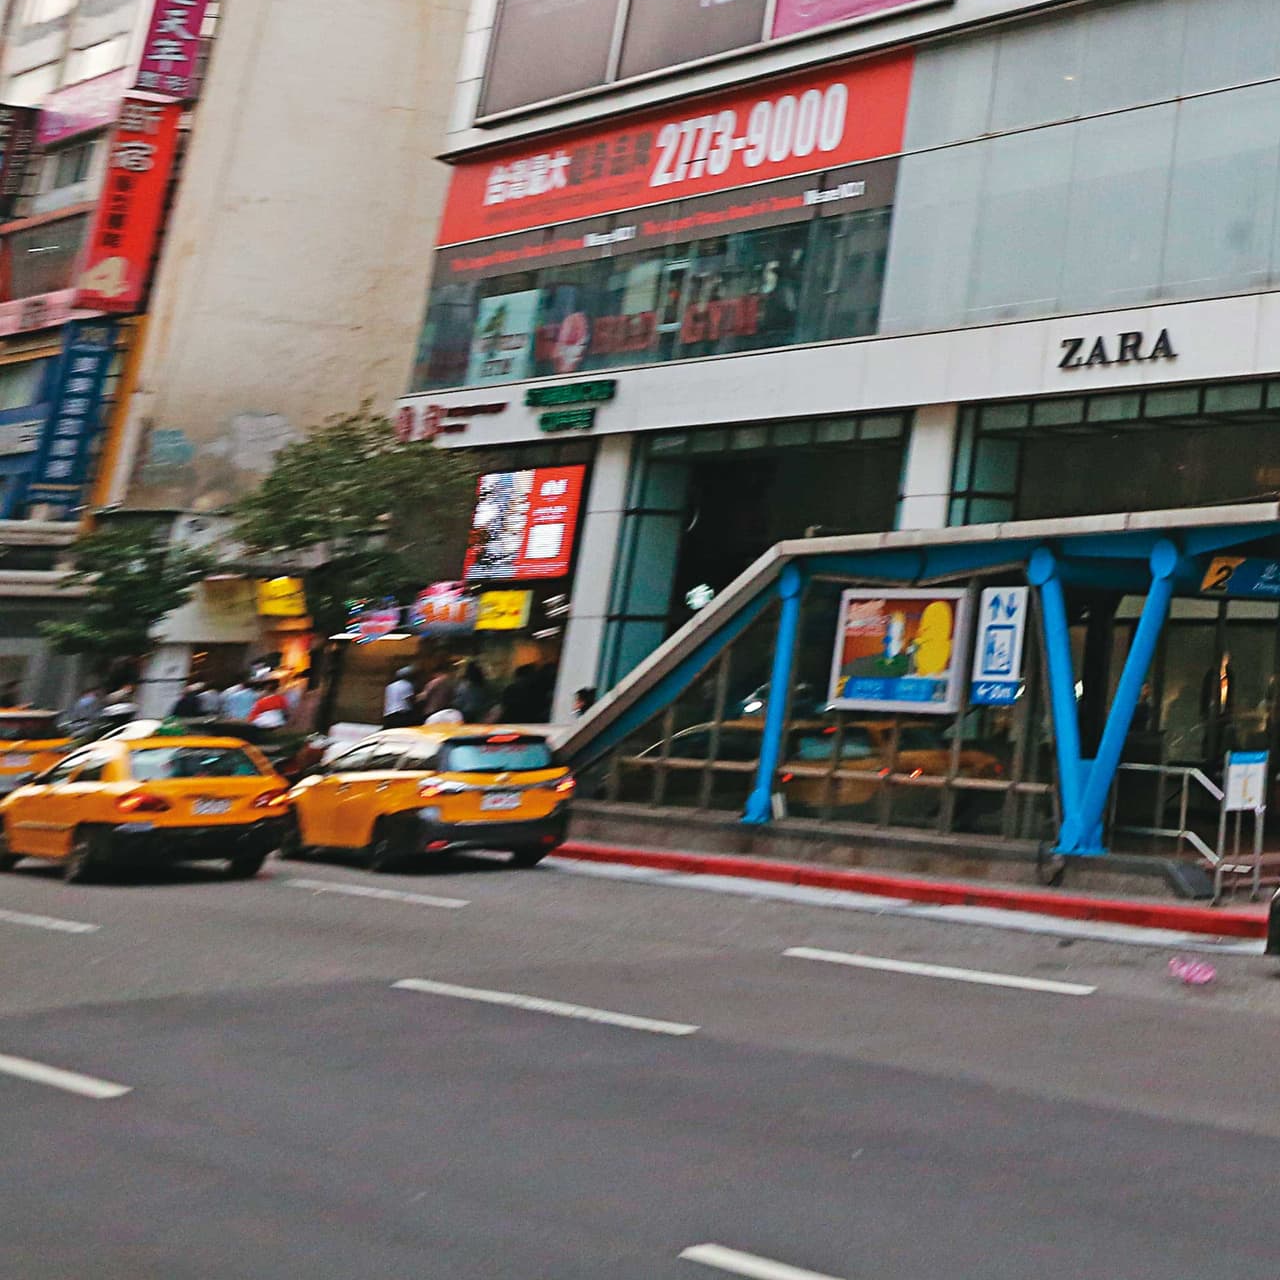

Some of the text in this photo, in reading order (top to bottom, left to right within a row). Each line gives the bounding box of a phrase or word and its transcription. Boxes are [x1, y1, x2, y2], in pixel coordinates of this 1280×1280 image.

[649, 82, 849, 188] 2773-9000
[1058, 328, 1179, 368] ZARA
[1212, 565, 1233, 591] 2
